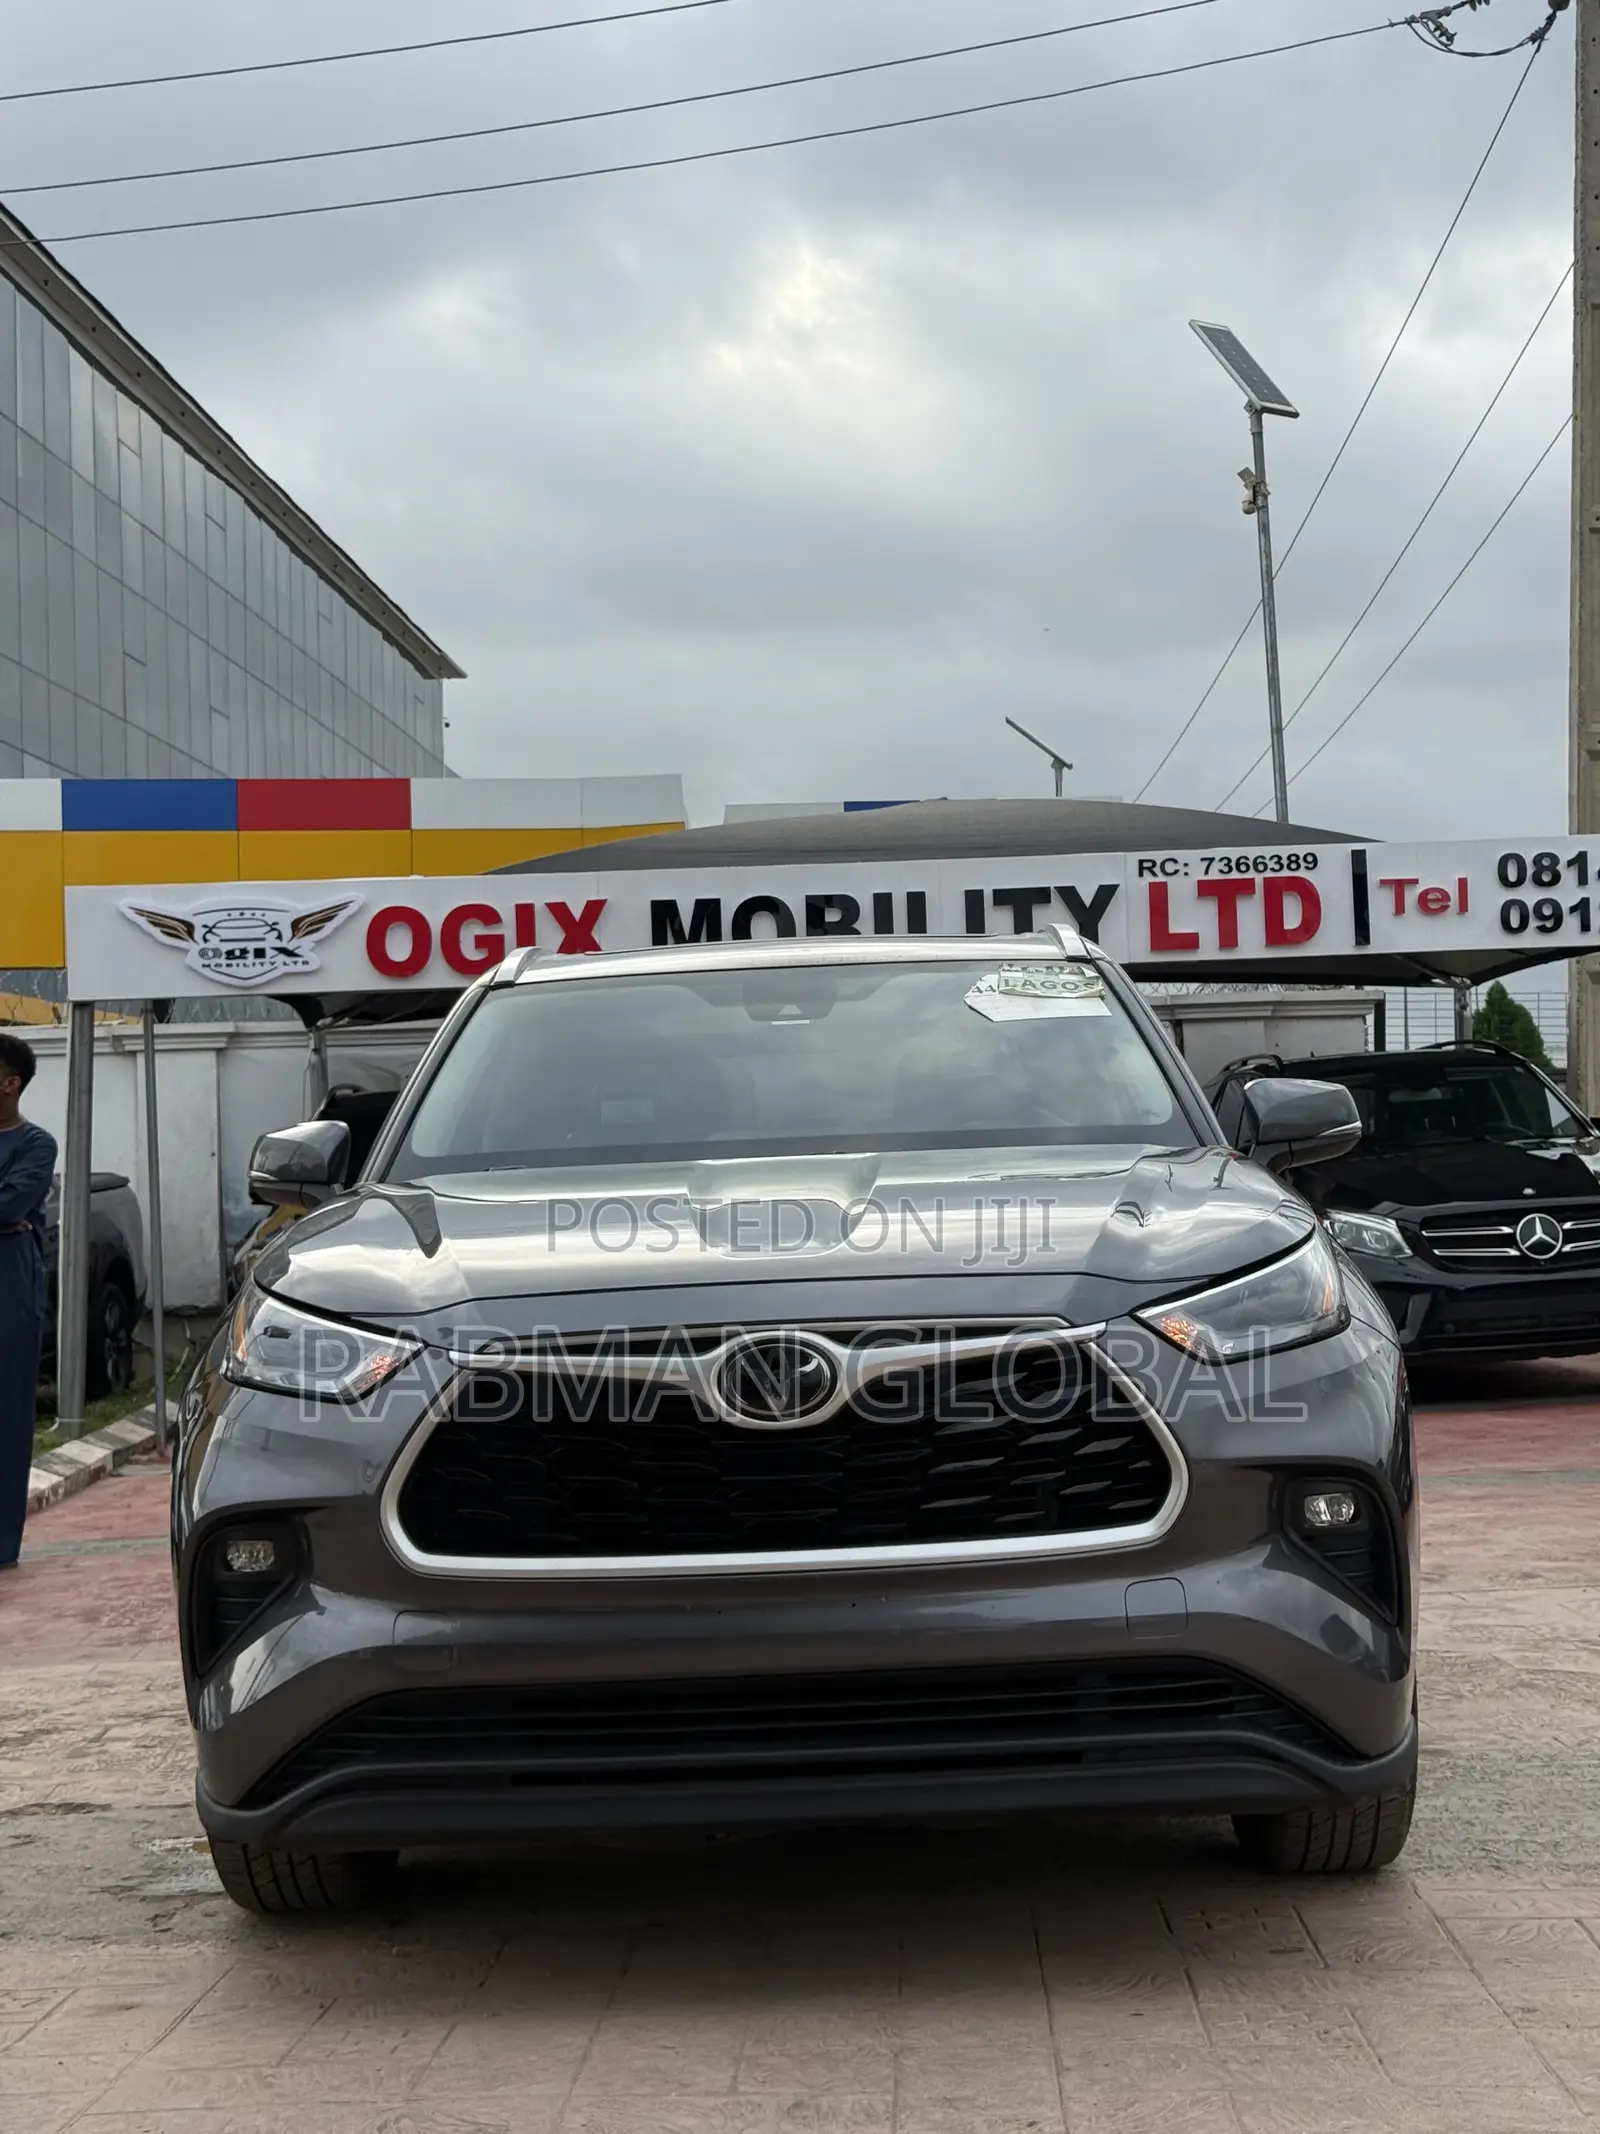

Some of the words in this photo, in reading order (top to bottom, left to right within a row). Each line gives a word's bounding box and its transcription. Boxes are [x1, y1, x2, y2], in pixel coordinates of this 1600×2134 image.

[1138, 857, 1189, 877] RC:
[1200, 852, 1319, 876] 7366389
[1497, 850, 1600, 888] 081
[1379, 877, 1469, 916] Tel
[366, 899, 608, 978] OGIX
[1148, 875, 1322, 952] LTD
[1500, 897, 1600, 934] 091
[201, 960, 277, 968] MOBILITY
